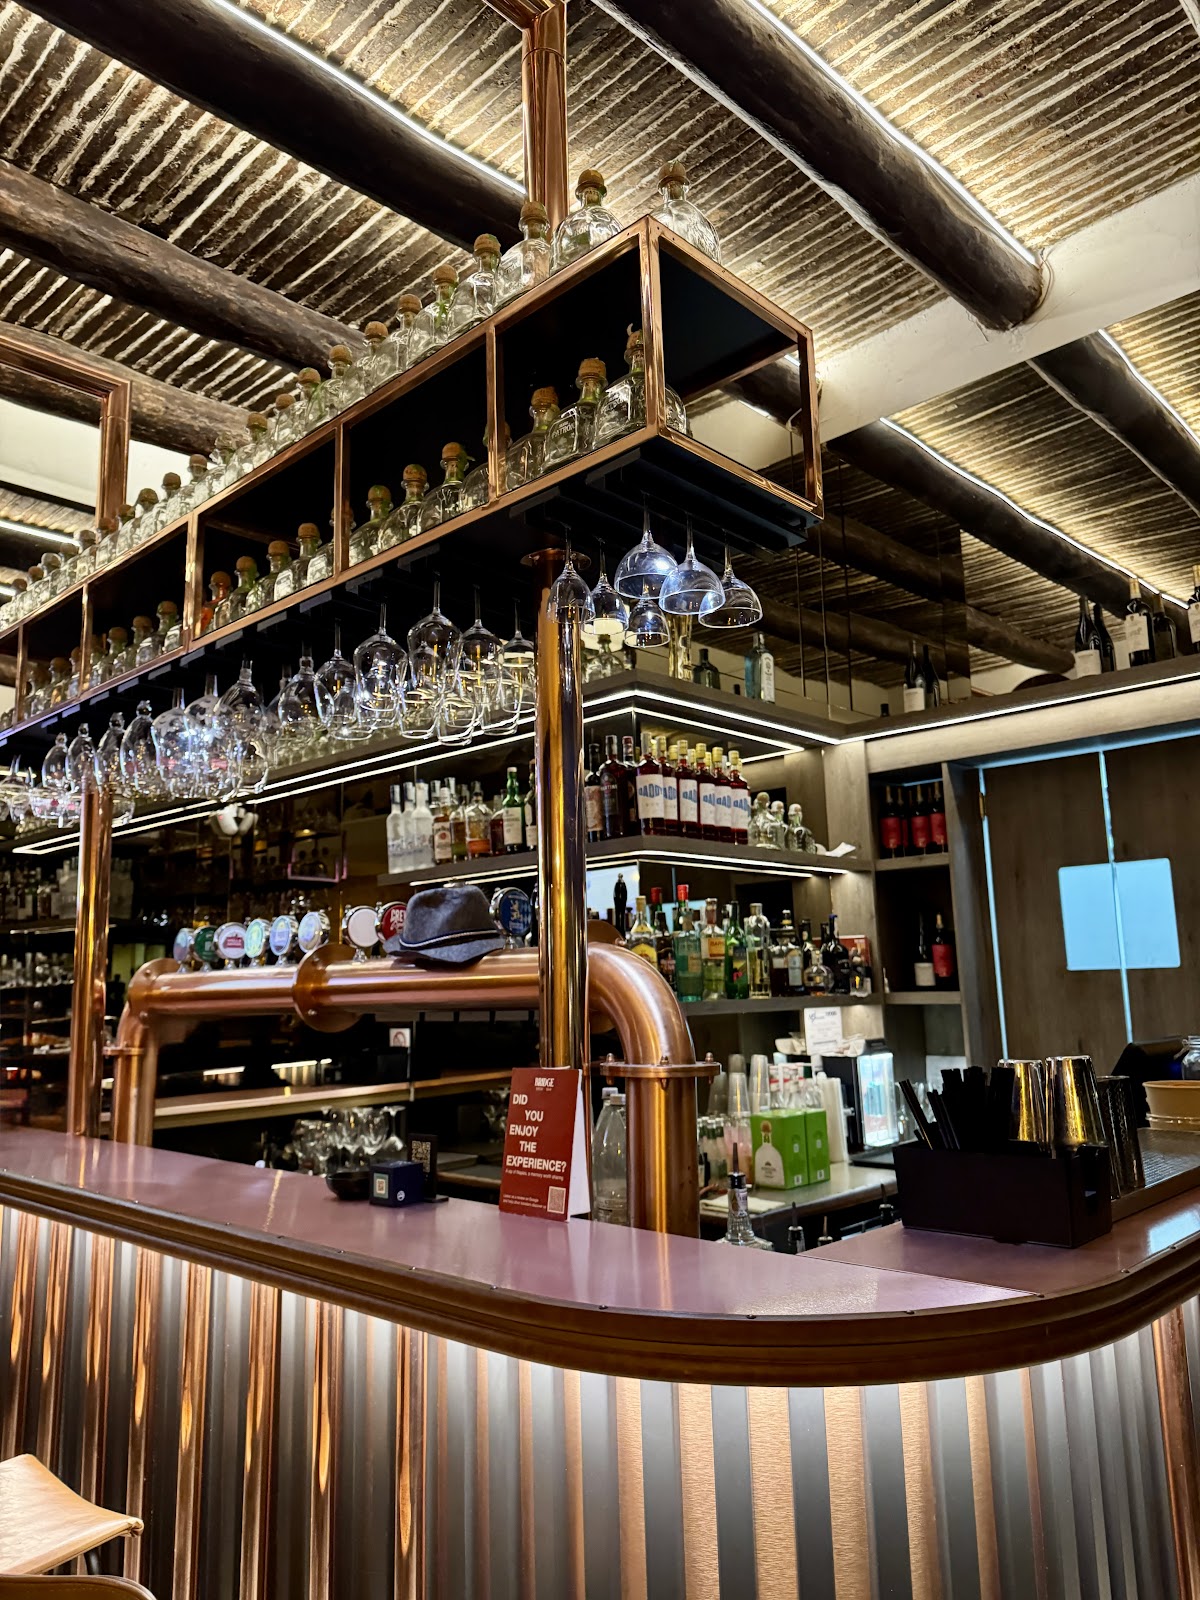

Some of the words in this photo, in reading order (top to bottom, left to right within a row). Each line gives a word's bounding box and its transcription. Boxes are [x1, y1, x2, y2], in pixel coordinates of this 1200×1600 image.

[512, 1093, 528, 1105] DID
[524, 1109, 544, 1122] YOU
[509, 1124, 539, 1137] ENJOY
[519, 1140, 537, 1153] THE
[506, 1155, 567, 1173] EXPERIENCE?
